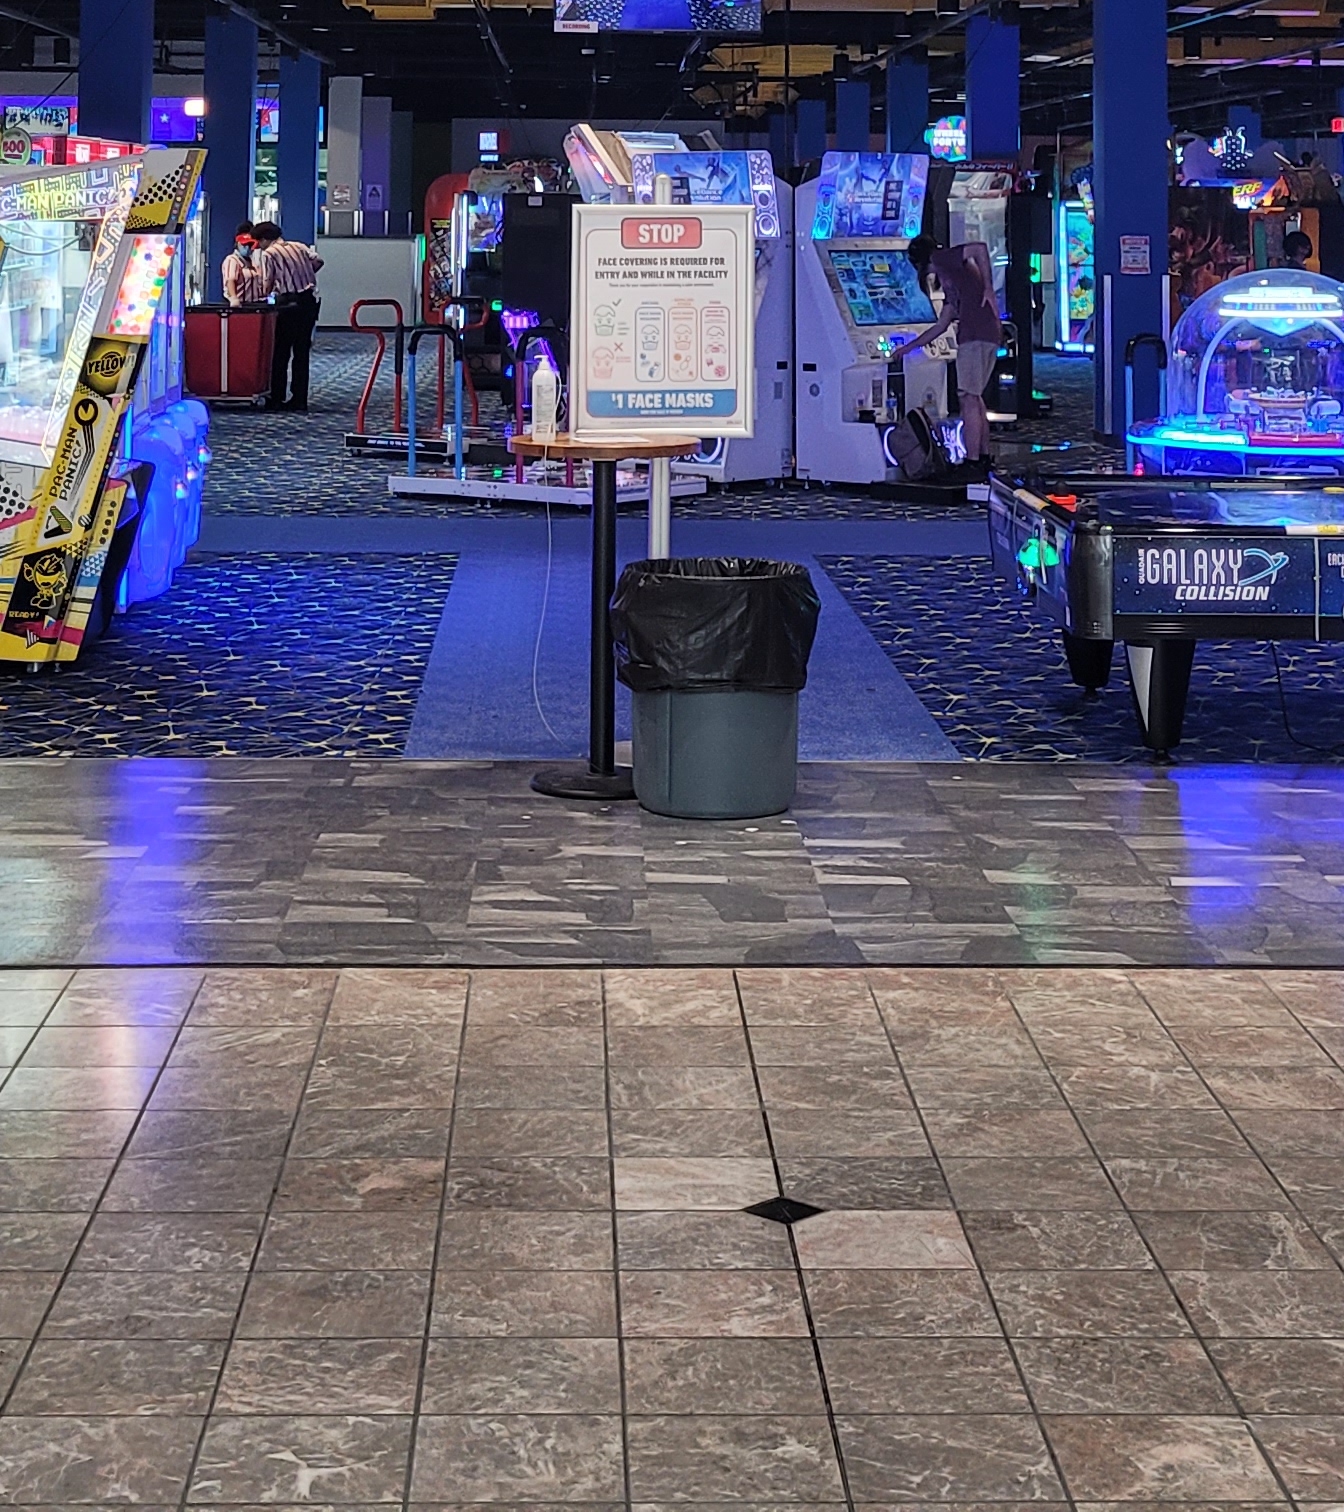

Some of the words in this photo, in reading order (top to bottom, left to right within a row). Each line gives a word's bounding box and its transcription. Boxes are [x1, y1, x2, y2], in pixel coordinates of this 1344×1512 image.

[933, 137, 966, 146] FORTU
[1232, 182, 1261, 196] ERF
[638, 223, 686, 244] STOP
[598, 257, 617, 266] FACE
[619, 257, 658, 266] COVERING
[659, 257, 668, 266] IS
[669, 257, 708, 266] REQUIRED
[709, 257, 725, 266] FOR
[595, 270, 620, 279] ENTRY
[622, 270, 638, 279] AND
[640, 270, 664, 279] WHILE
[666, 270, 675, 279] IN
[677, 270, 692, 279] THE
[693, 270, 728, 279] FACILITY
[627, 393, 661, 408] FACE
[664, 393, 714, 408] MASKS
[48, 426, 77, 498] PAC-MAN
[59, 440, 83, 502] PANIC!
[1138, 548, 1146, 584] QUADAIR
[1146, 548, 1244, 585] GALAXY
[1174, 586, 1270, 601] COLLISION
